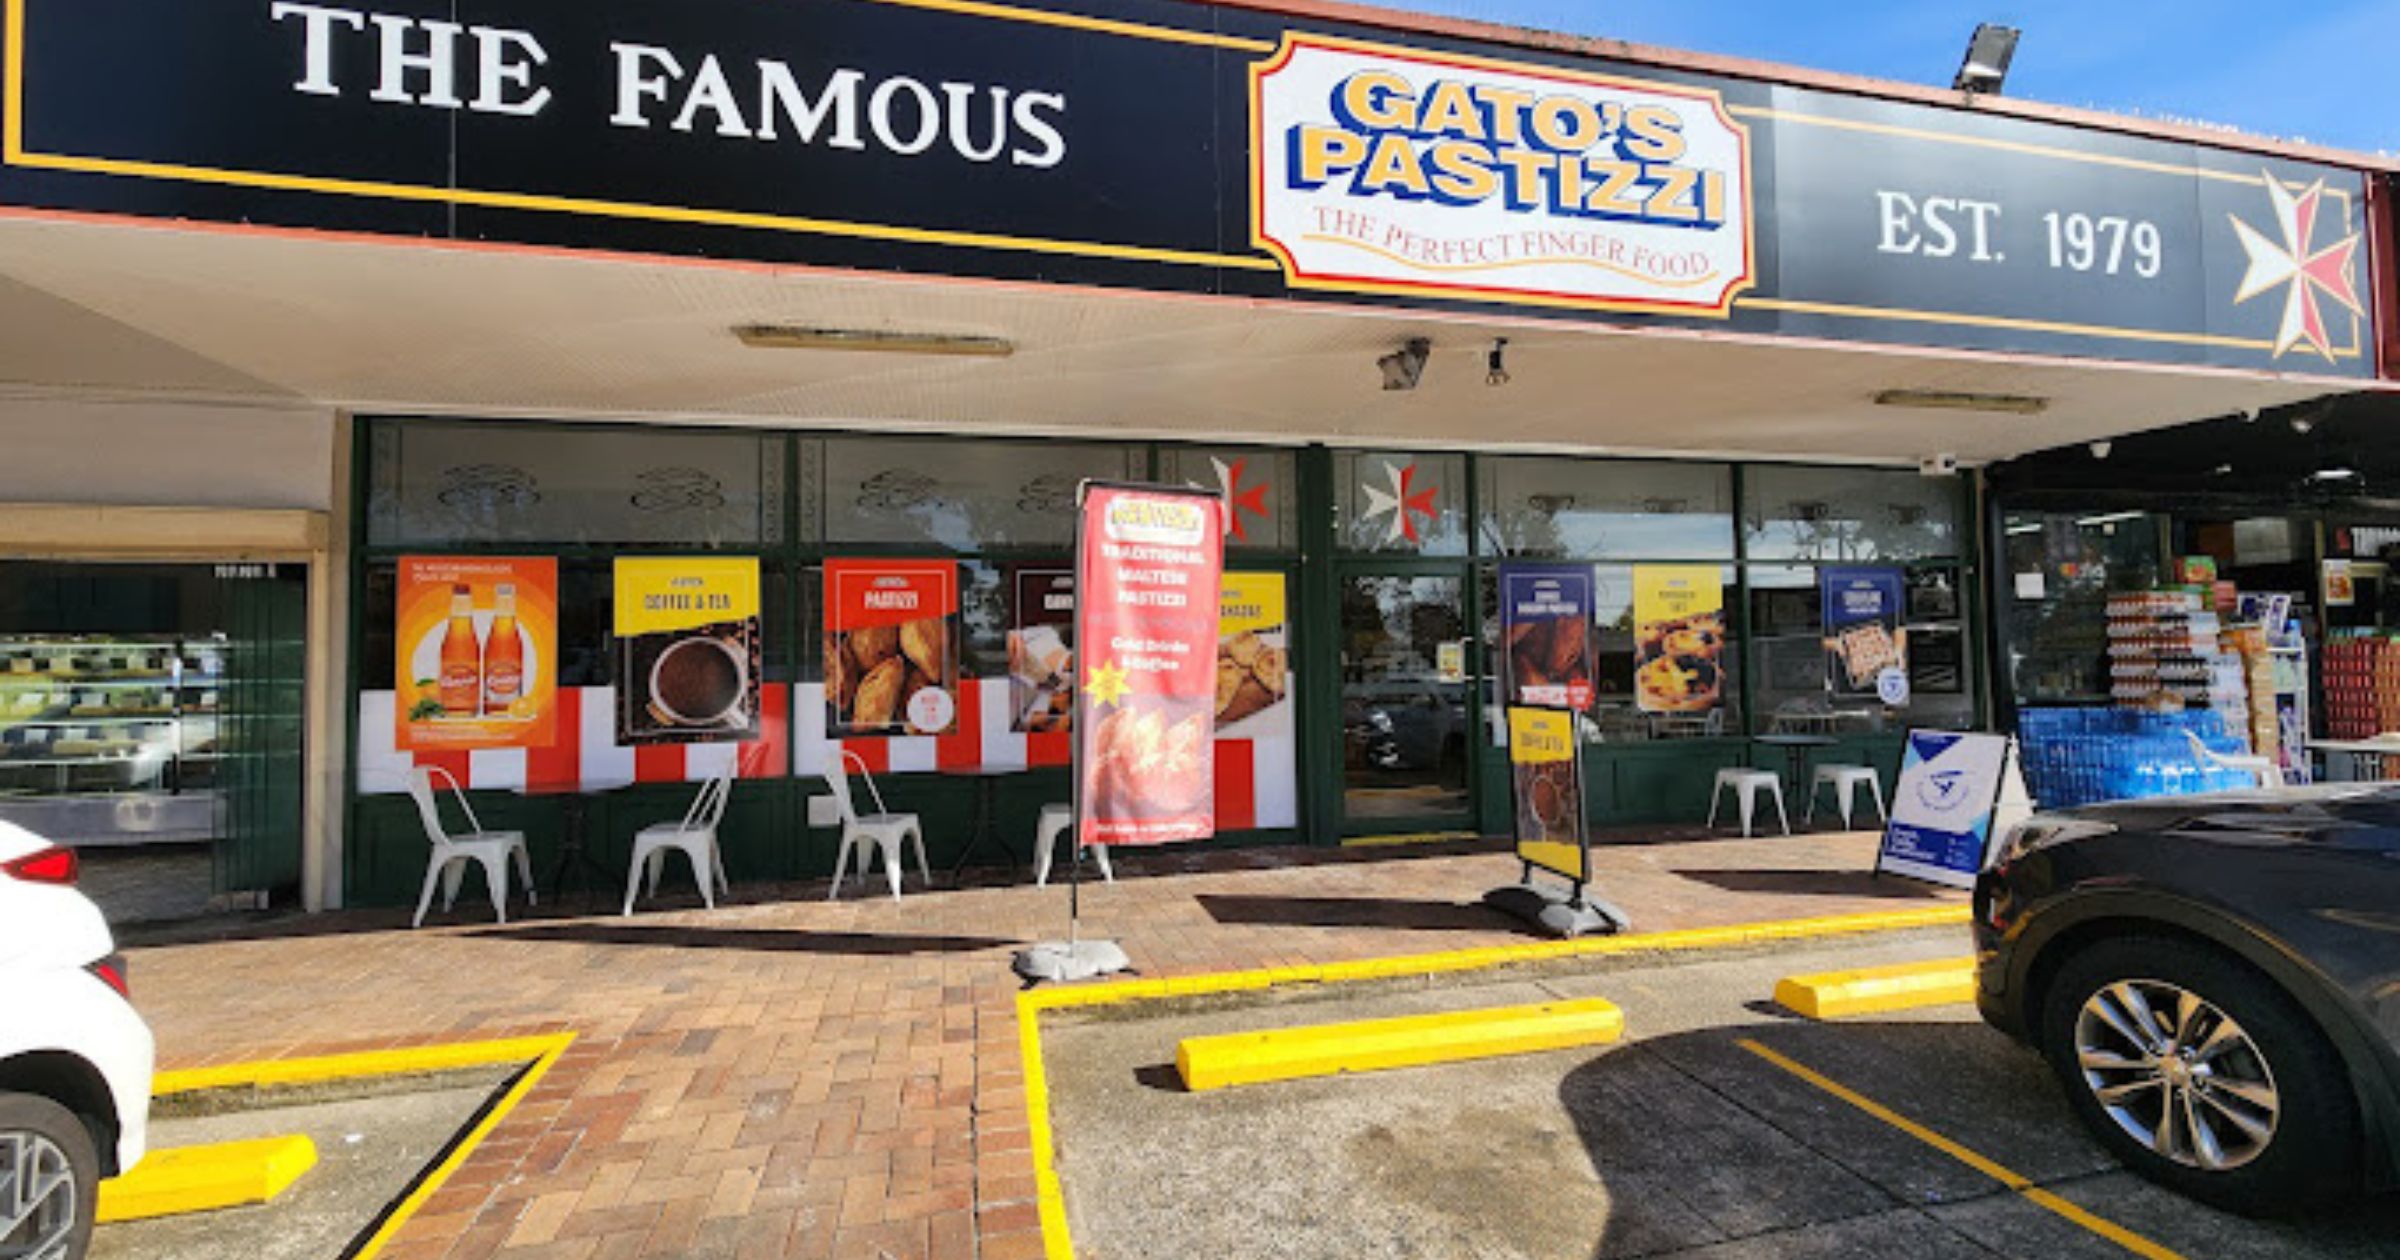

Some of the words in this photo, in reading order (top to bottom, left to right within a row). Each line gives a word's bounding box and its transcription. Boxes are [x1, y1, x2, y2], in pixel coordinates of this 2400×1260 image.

[271, 1, 552, 117] THE
[609, 41, 1067, 168] FAMOUS
[1330, 69, 1688, 163] GATO'S
[1287, 123, 1727, 231] PASTIZZI
[1314, 206, 1378, 240] THE
[1384, 222, 1517, 265] PERFECT
[1521, 230, 1627, 262] FINGER
[1633, 245, 1710, 278] FOOD
[1876, 188, 2006, 263] EST.
[2043, 210, 2162, 279] 1979
